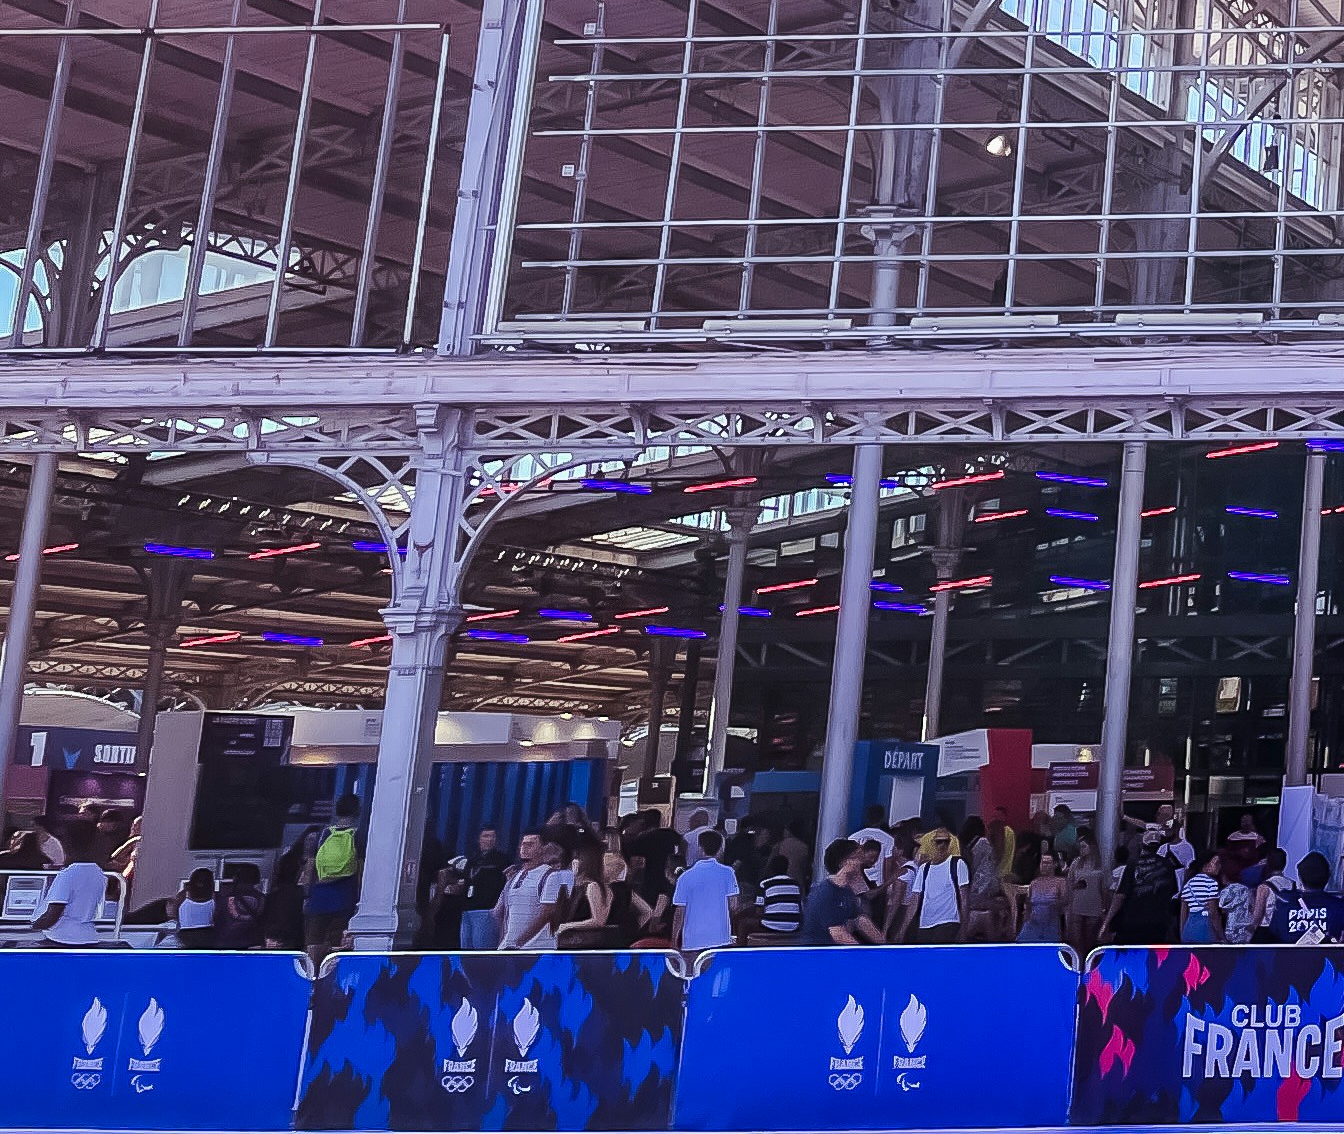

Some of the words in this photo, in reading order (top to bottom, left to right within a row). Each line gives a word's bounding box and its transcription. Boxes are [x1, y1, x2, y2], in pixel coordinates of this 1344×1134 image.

[30, 732, 48, 766] 1
[884, 746, 924, 769] DÉPART
[1232, 1005, 1300, 1027] CLUB
[1182, 1013, 1344, 1078] FRANCE
